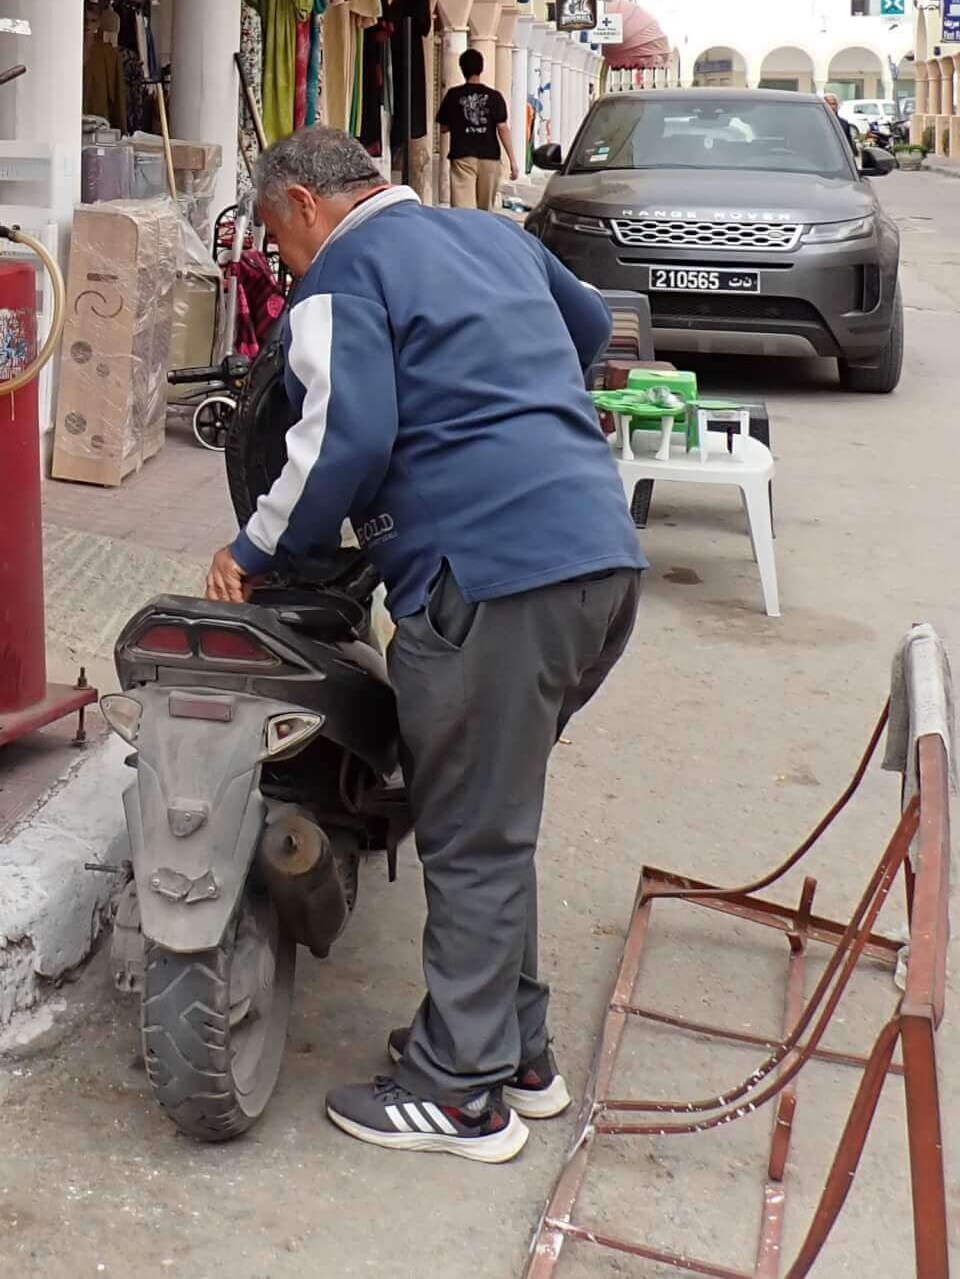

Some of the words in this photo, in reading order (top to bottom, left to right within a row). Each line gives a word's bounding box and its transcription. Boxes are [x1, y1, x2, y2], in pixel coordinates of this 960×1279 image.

[622, 209, 697, 219] RANGE
[714, 211, 791, 221] ROVER
[655, 270, 720, 289] 210565
